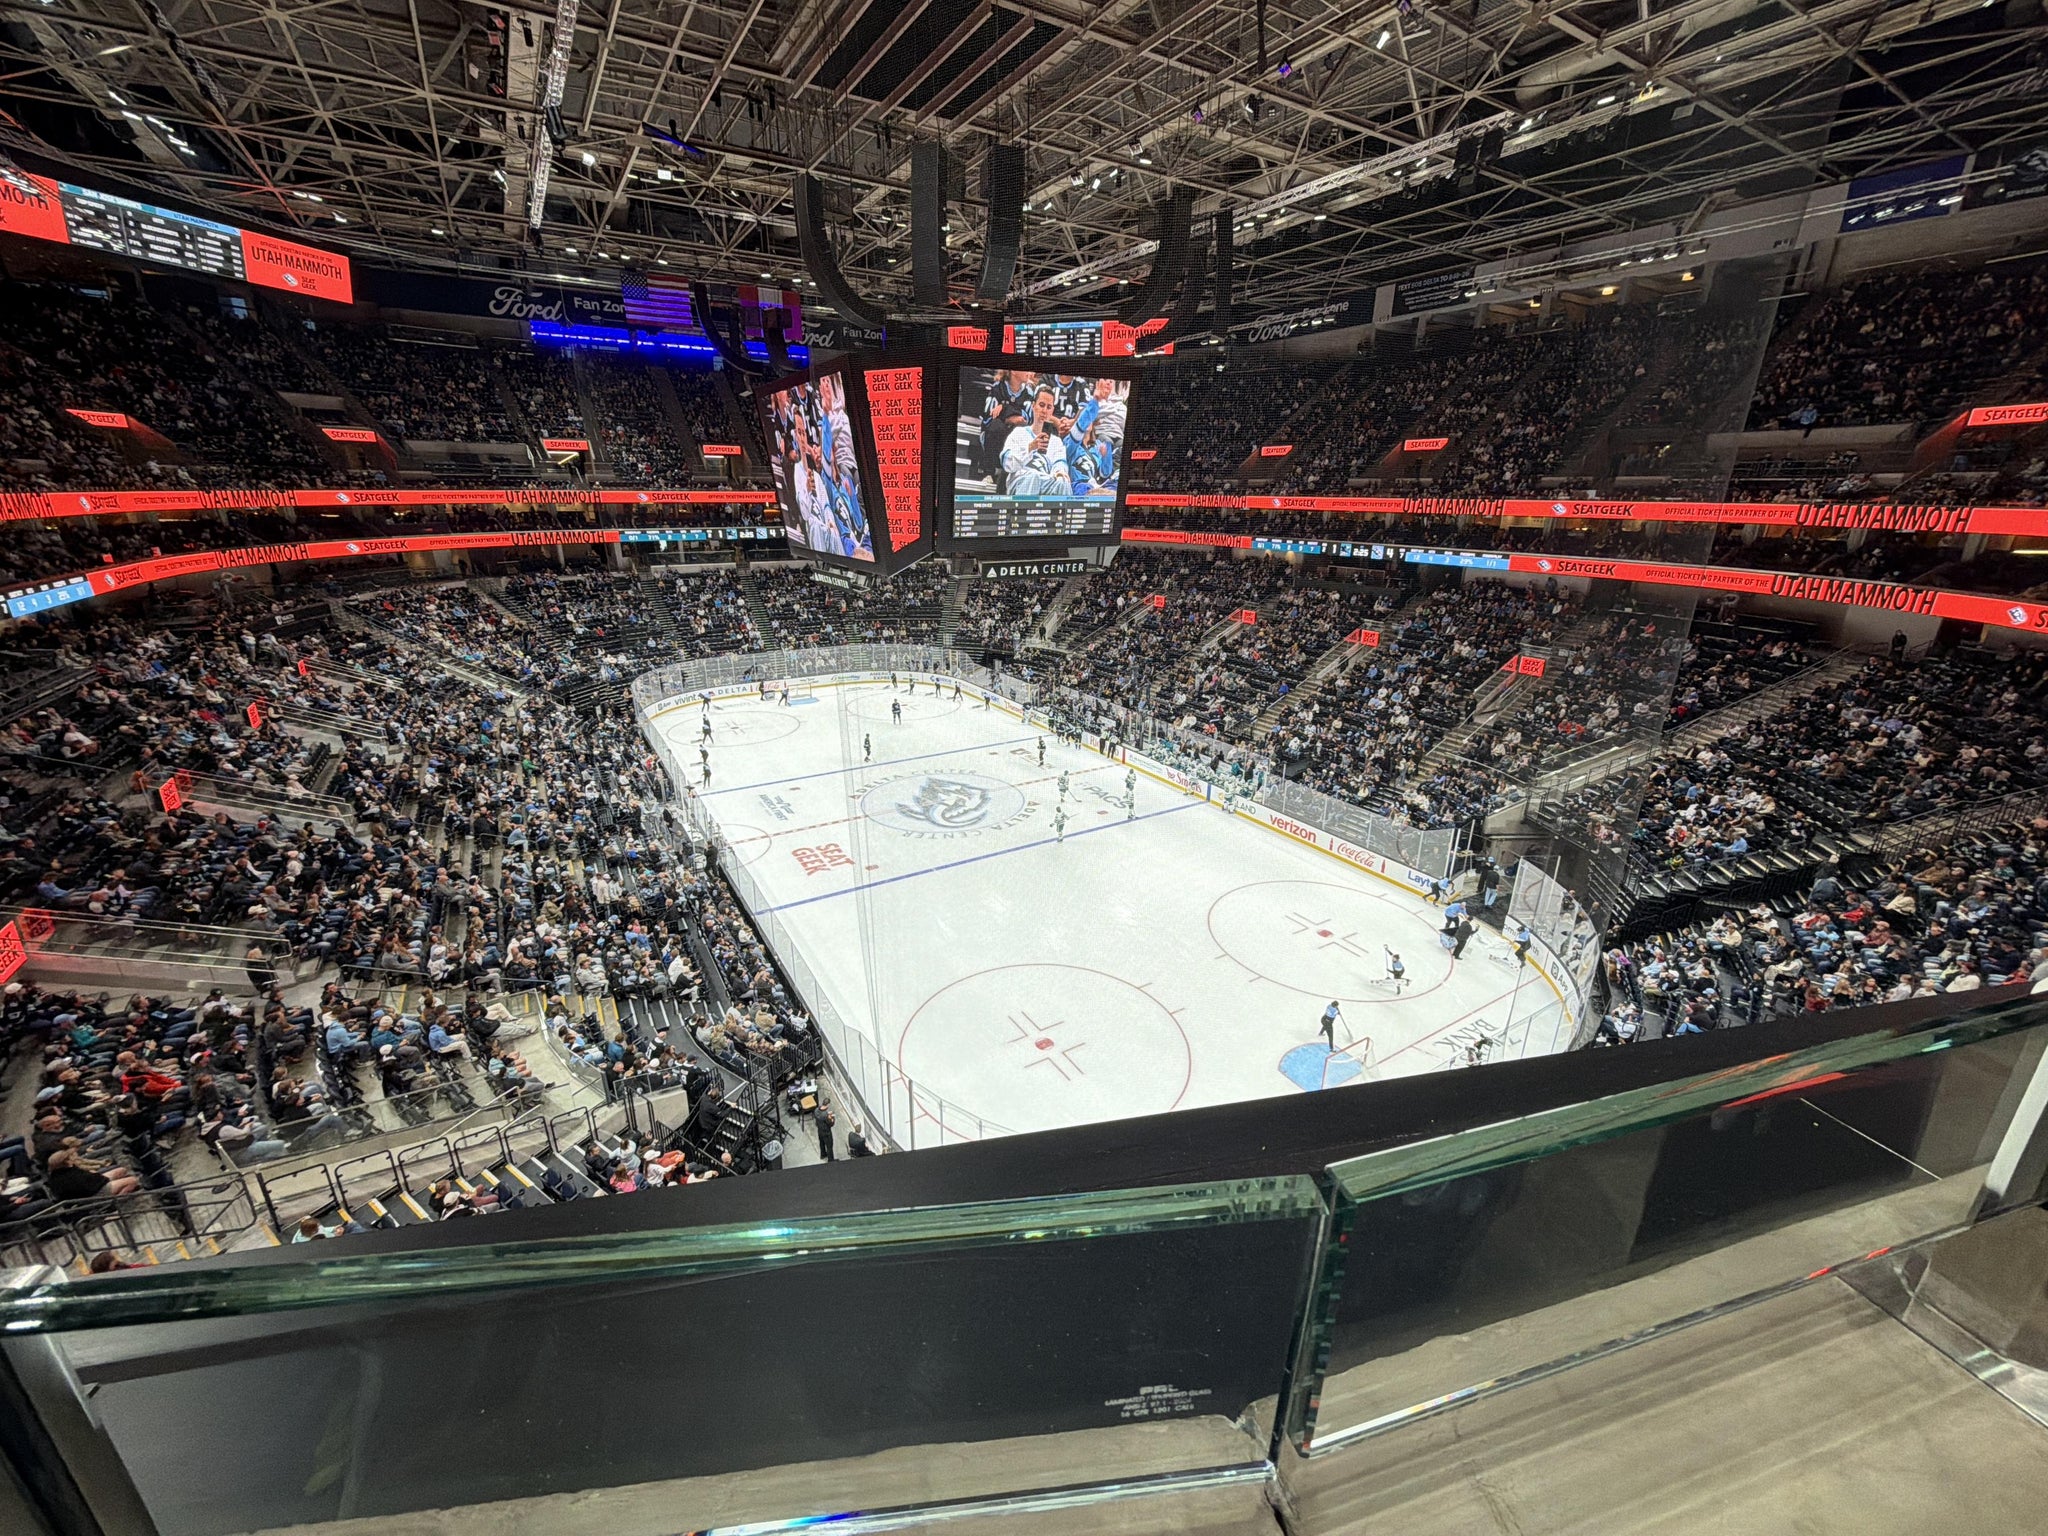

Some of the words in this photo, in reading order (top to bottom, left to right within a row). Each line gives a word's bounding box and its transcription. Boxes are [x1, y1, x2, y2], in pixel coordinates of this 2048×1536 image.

[251, 246, 283, 266] UTAH
[285, 254, 343, 280] MAMMOTH
[301, 276, 315, 285] SEAT
[301, 283, 317, 292] GEEK
[488, 286, 563, 320] Ford
[574, 296, 600, 311] Fan
[602, 300, 624, 313] Zo
[842, 327, 862, 338] Fan
[864, 329, 883, 340] Zon
[1248, 314, 1293, 343] Ford
[953, 335, 972, 345] UTAH
[1107, 330, 1126, 341] UTAH
[872, 374, 888, 383] SEAT
[894, 372, 911, 381] SEAT
[872, 382, 889, 391] GEEK
[894, 381, 912, 390] GEEK
[885, 399, 902, 407] SEAT
[885, 408, 903, 417] GEEK
[907, 407, 921, 416] GEE
[878, 424, 894, 433] SEAT
[899, 423, 915, 432] SEAT
[331, 430, 369, 440] SEATGEEK
[878, 433, 895, 442] GEEK
[899, 432, 917, 441] GEEK
[550, 440, 584, 449] SEATGEEK
[1266, 446, 1287, 454] SEATGEEK
[1410, 440, 1441, 449] SEATGEEK
[890, 448, 906, 457] SEAT
[890, 457, 908, 465] GEEK
[883, 473, 898, 481] SEAT
[903, 472, 919, 481] SEAT
[883, 481, 899, 489] GEEK
[903, 480, 921, 489] GEEK
[90, 494, 121, 510] SEATGEEK
[199, 490, 231, 508] UTAH
[233, 490, 297, 508] MAMMOTH
[354, 492, 400, 503] SEATGEEK
[505, 491, 537, 504] UTAH
[539, 490, 602, 504] MAMMOTH
[652, 492, 691, 501] SEATGEEK
[895, 495, 910, 504] SEAT
[1187, 494, 1207, 508] UTAH
[1207, 495, 1247, 508] MAMMOTH
[895, 504, 912, 512] GEEK
[1283, 499, 1316, 509] SEATGEEK
[1402, 498, 1433, 514] UTAH
[1434, 499, 1504, 517] MAMMOTH
[1572, 503, 1635, 517] SEATGEEK
[1665, 507, 1695, 516] OFFICIAL
[1697, 508, 1734, 517] TICKETING
[1735, 509, 1767, 518] PARTNER
[1768, 510, 1778, 518] OF
[1780, 510, 1793, 519] THE
[1796, 504, 1849, 528] UTAH
[1852, 505, 1970, 533] MAMMOTH
[888, 518, 902, 526] SEAT
[740, 531, 754, 539] 2:25
[769, 530, 776, 538] 4
[888, 526, 904, 534] GEEK
[907, 526, 921, 535] GEE
[511, 532, 542, 546] UTAH
[544, 531, 606, 545] MAMMOTH
[1184, 532, 1203, 545] UTAH
[1203, 533, 1241, 548] MAMMOTH
[364, 540, 409, 552] SEATGEEK
[215, 549, 245, 568] UTAH
[246, 543, 309, 567] MAMMOTH
[1332, 544, 1337, 554] 1
[1353, 548, 1369, 557] 2:25
[1386, 548, 1394, 559] 4
[1459, 558, 1474, 566] 29%
[1486, 559, 1497, 567] 1/1
[1000, 566, 1039, 577] DELTA
[1043, 562, 1084, 574] CENTER
[1557, 560, 1616, 576] SEATGEEK
[115, 567, 143, 586] SEATGEEK
[818, 574, 833, 585] DELTA
[833, 577, 850, 590] CENTER
[1646, 570, 1676, 579] OFFICIAL
[1677, 572, 1712, 582] TICKETING
[1713, 575, 1744, 586] PARTNER
[1744, 578, 1754, 586] OF
[1755, 579, 1769, 588] THE
[1771, 575, 1820, 600] UTAH
[1824, 580, 1937, 615] MAMMOTH
[1525, 659, 1541, 668] SEAT
[718, 686, 748, 696] DELTA
[674, 694, 697, 706] vivint
[855, 774, 904, 795] DELTA
[912, 768, 977, 776] CENTER
[991, 807, 1037, 831] DELTA
[1269, 814, 1317, 843] verizon
[902, 831, 982, 840] CENTER
[816, 843, 856, 867] SEAT
[1336, 843, 1377, 868] Coca-Cola
[791, 847, 831, 877] GEEK
[1408, 870, 1432, 888] Layt
[1433, 1018, 1499, 1052] BANK
[1188, 1388, 1212, 1397] GLASS
[1134, 1408, 1149, 1416] CFR
